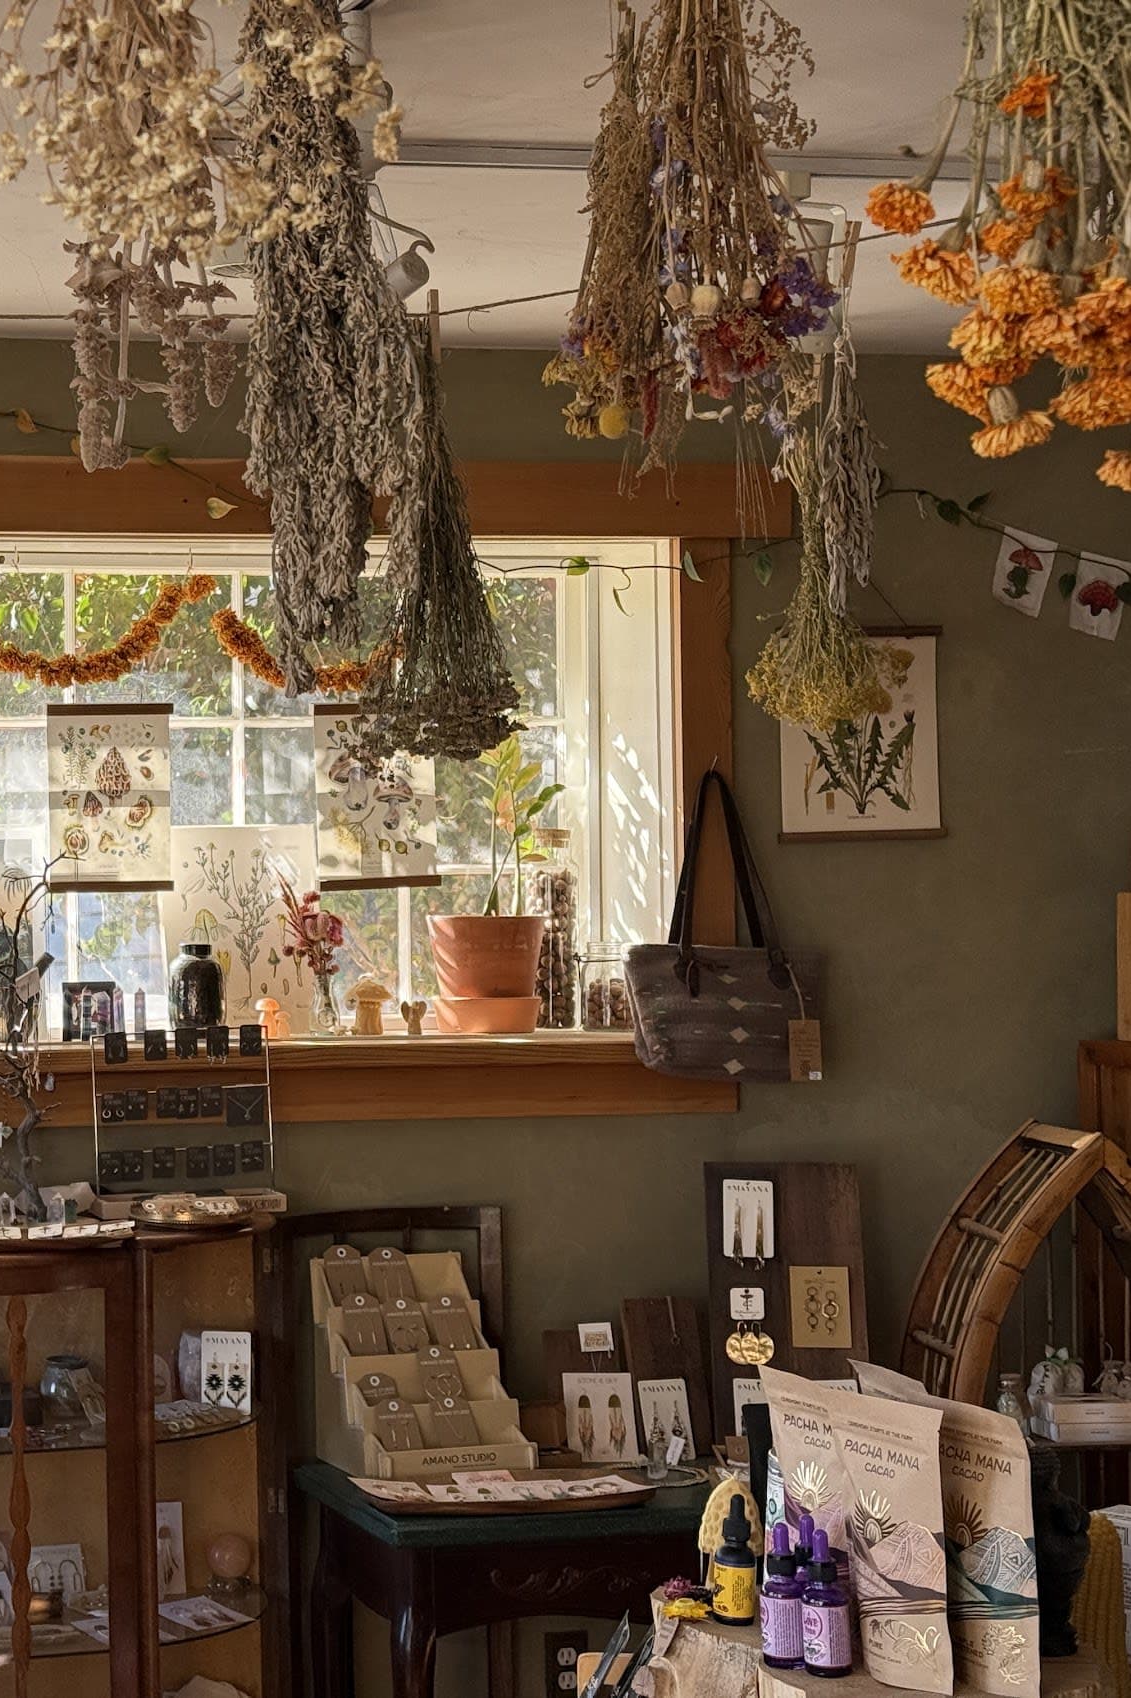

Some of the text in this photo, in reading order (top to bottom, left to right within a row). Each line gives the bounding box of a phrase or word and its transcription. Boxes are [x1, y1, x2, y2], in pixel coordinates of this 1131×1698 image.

[783, 1413, 818, 1432] PACHA
[804, 1435, 832, 1450] CACAO
[422, 1452, 497, 1465] AMANO STUDIO
[844, 1439, 920, 1471] PACHA MANA
[939, 1443, 1012, 1476] ACHA MANA
[864, 1462, 896, 1479] CACAO
[951, 1465, 985, 1482] CACAO
